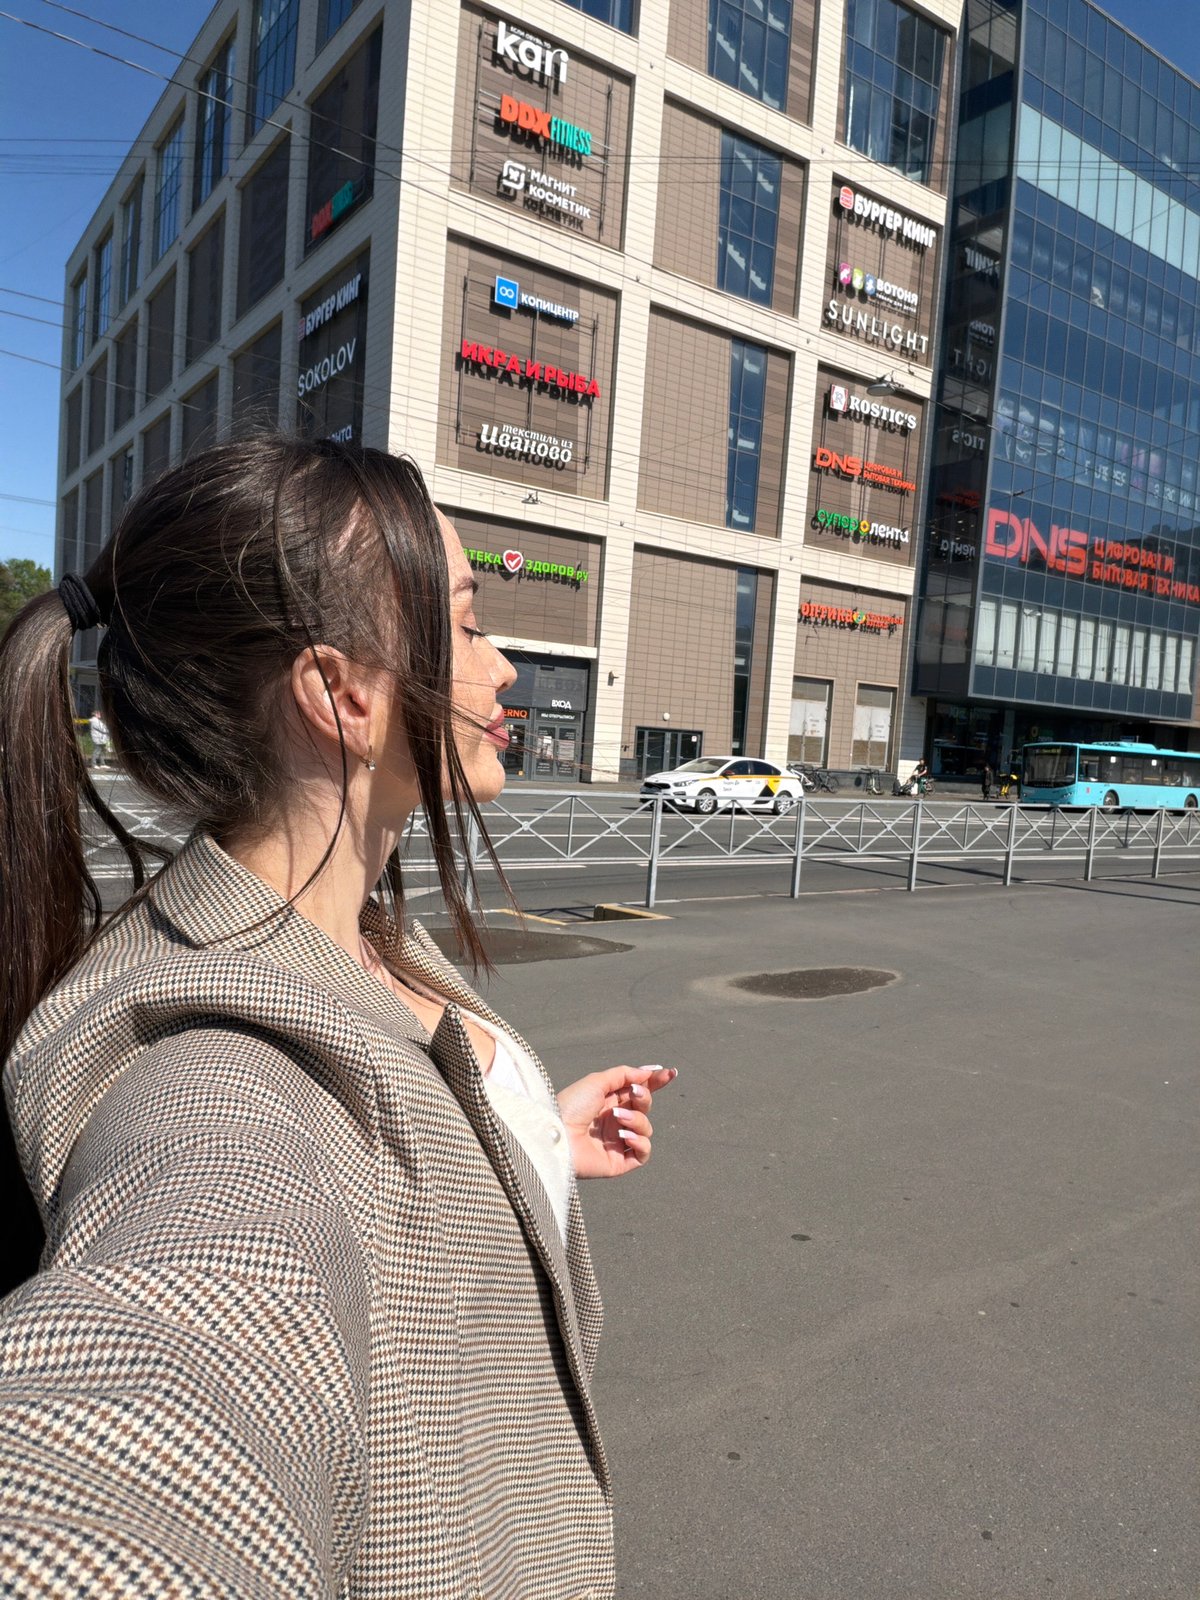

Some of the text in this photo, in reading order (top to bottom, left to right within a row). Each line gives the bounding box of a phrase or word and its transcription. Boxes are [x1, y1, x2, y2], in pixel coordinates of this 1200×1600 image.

[496, 20, 569, 83] kari
[500, 94, 592, 156] DDX FITNESS
[528, 184, 591, 219] КОСМЕТИК
[530, 169, 577, 197] МАГНИТ
[853, 193, 936, 248] БУРГЕР КИНГ
[305, 273, 361, 336] БУРГЕР КИНГ
[521, 293, 579, 321] КОПИЦЕНТР
[877, 279, 918, 306] ВОТОНЯ
[828, 299, 928, 353] SUNLIGHT
[298, 338, 356, 397] SOKOLOV
[461, 339, 601, 398] ИКРА И РЫБА
[849, 394, 917, 429] ROSTIC'S
[480, 423, 572, 463] Иваново
[502, 423, 573, 449] текстиль из
[815, 447, 862, 476] DNS
[869, 522, 909, 542] лента
[985, 507, 1089, 575] DNS
[1094, 536, 1176, 573] ЦИФРОВАЯ И
[1092, 561, 1200, 603] БЫТОВАЯ ТЕХНИКА
[552, 699, 571, 710] ВХОД
